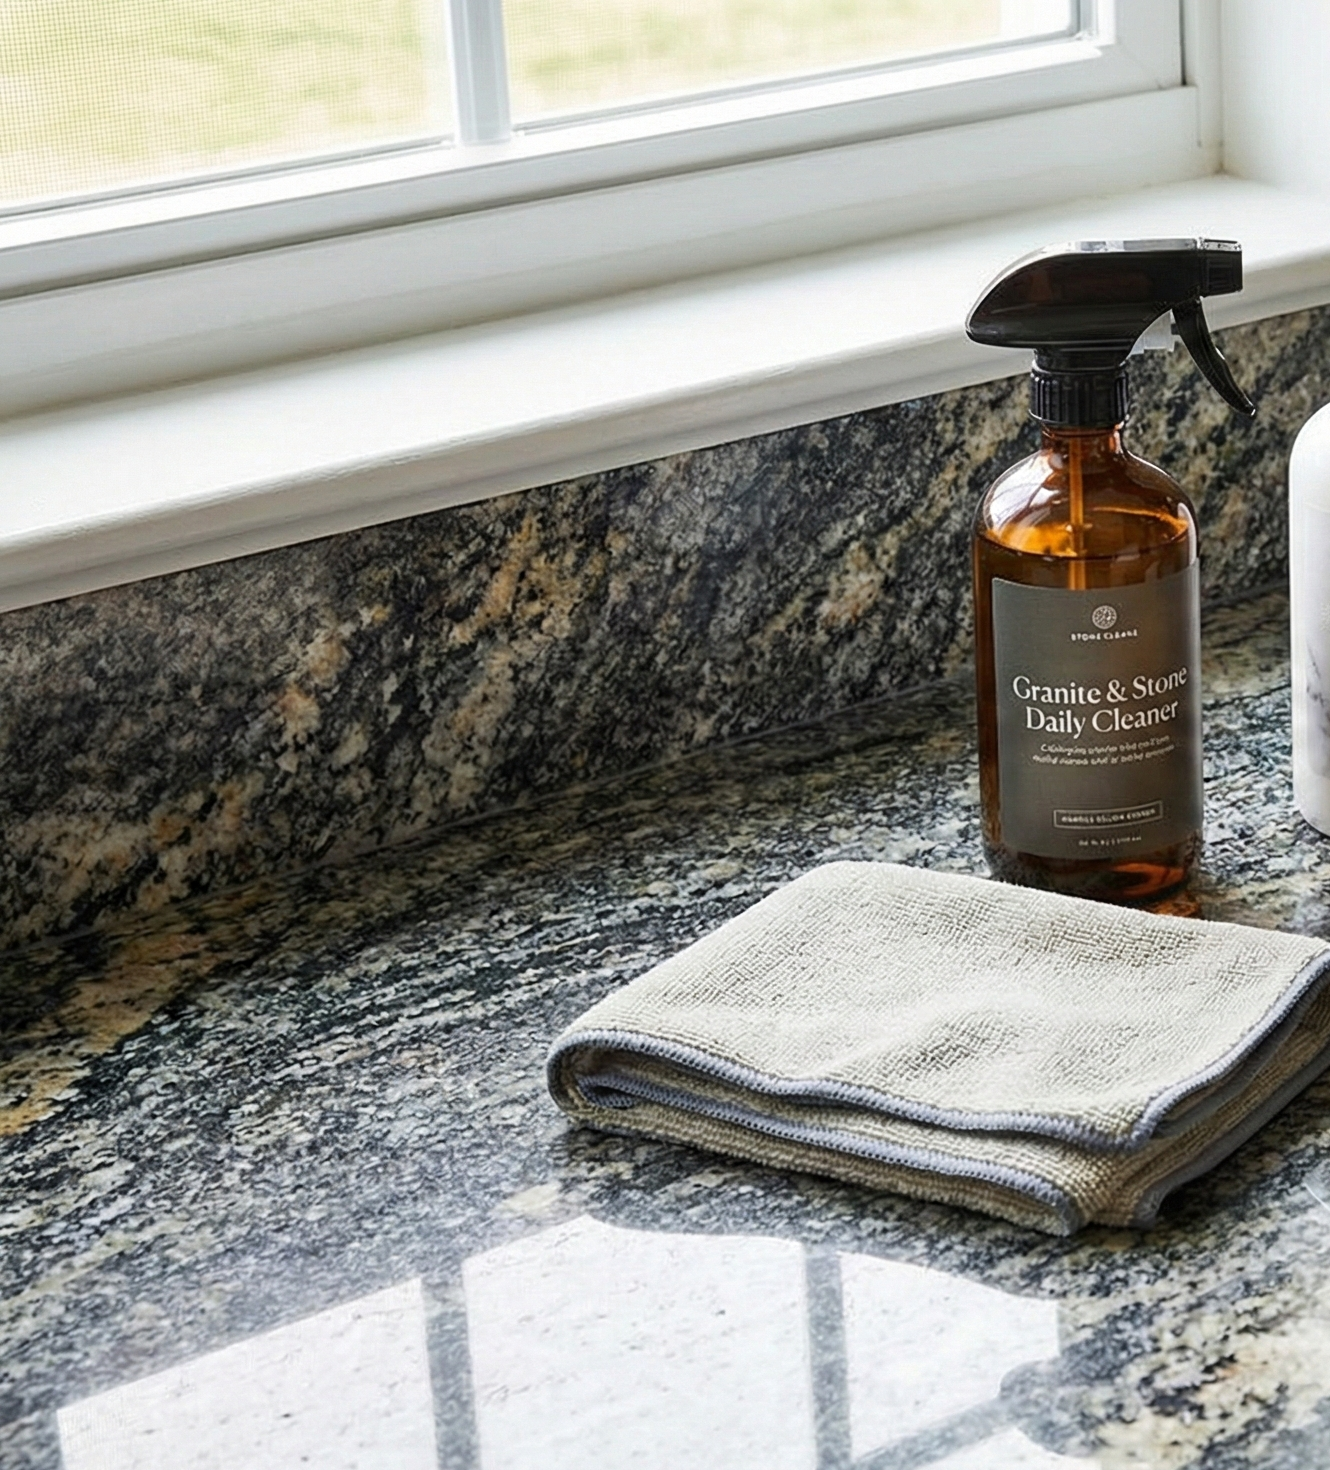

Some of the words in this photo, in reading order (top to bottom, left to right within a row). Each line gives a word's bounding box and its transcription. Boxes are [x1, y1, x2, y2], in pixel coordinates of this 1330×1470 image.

[1012, 675, 1101, 705] Granite
[1106, 679, 1128, 703] &
[1132, 667, 1188, 700] Stone
[1026, 706, 1086, 739] Daily
[1092, 701, 1179, 733] Cleaner
